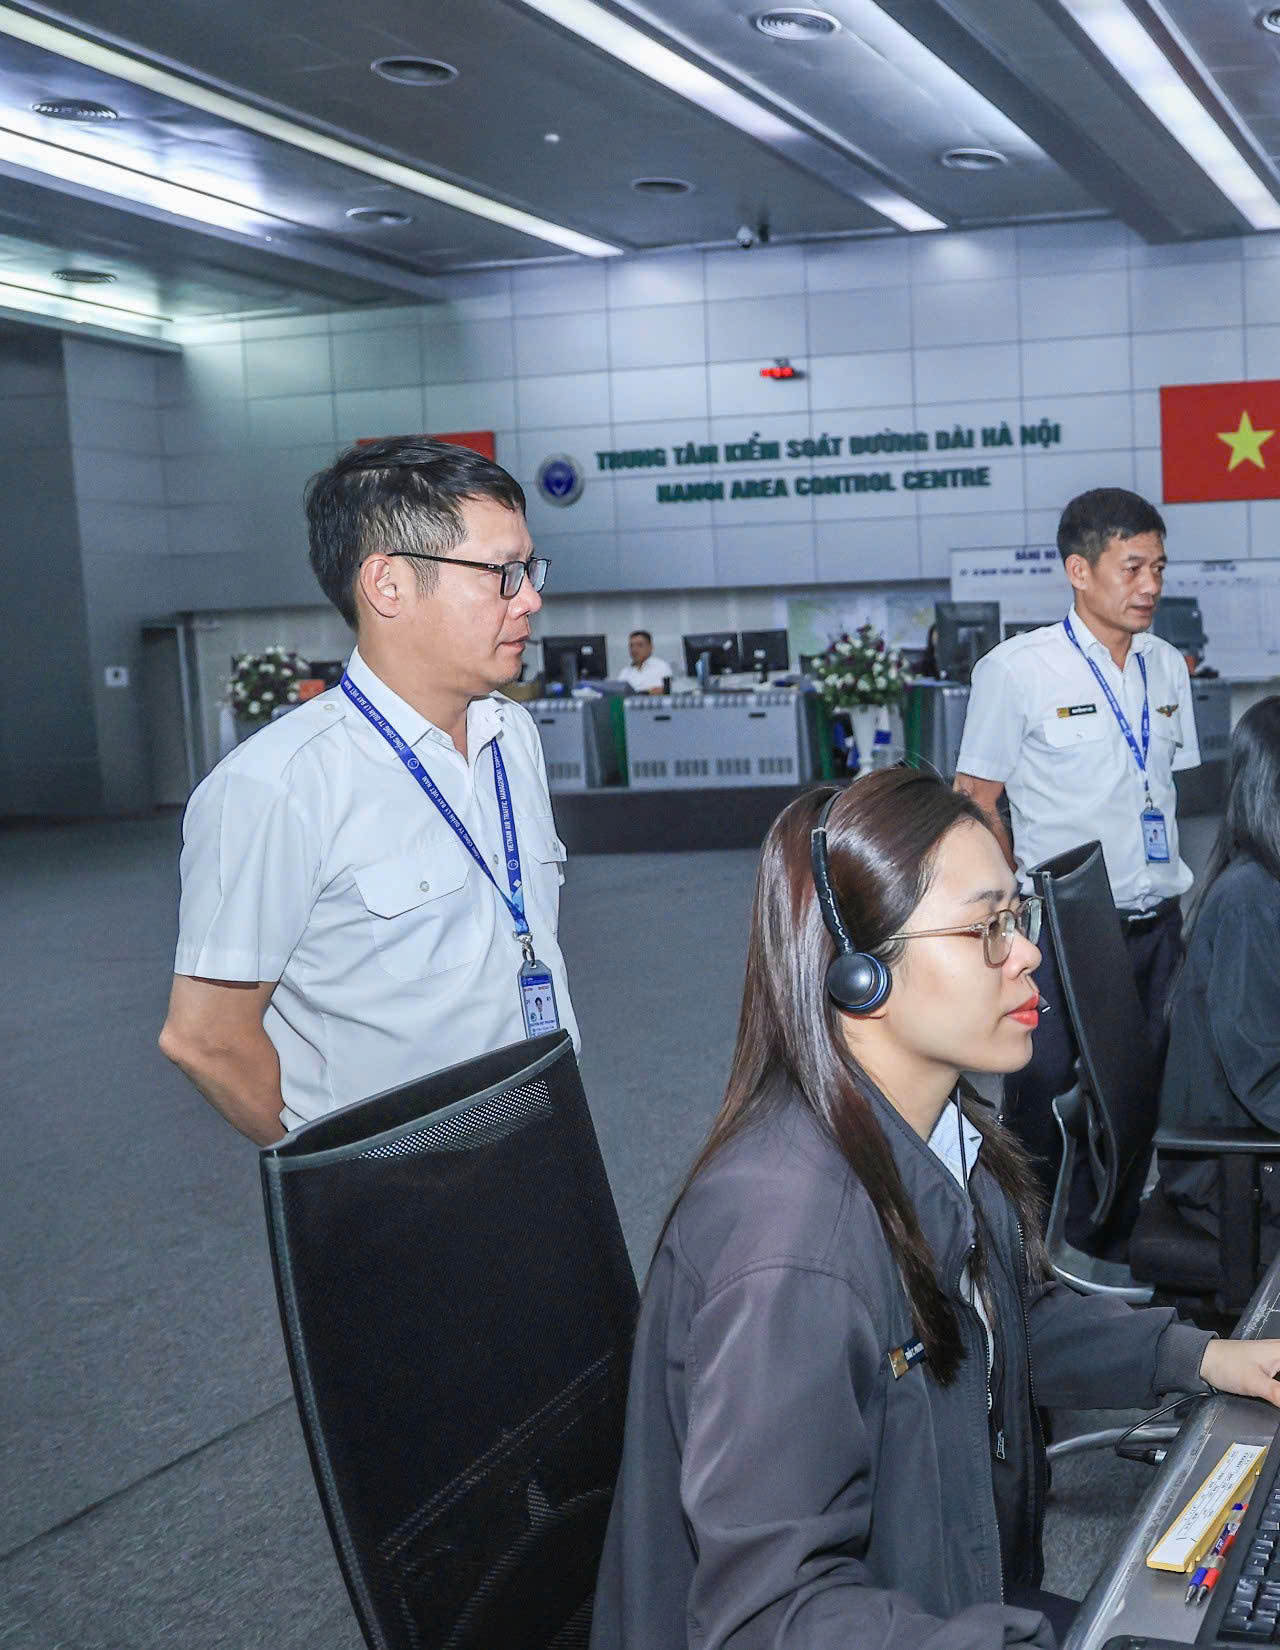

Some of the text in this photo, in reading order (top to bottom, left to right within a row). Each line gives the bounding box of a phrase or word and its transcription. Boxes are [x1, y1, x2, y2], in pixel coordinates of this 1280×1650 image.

[596, 448, 667, 471] TRUNG
[672, 441, 719, 465] TÂM
[725, 432, 780, 462] KIỂM
[787, 432, 843, 459] SOÁT
[981, 420, 1013, 447] HÀ
[1020, 418, 1061, 448] NỘI
[657, 466, 991, 503] HANOI AREA CONTROL CENTRE
[501, 800, 509, 820] TRAFFIC
[504, 830, 514, 852] VIETNAM
